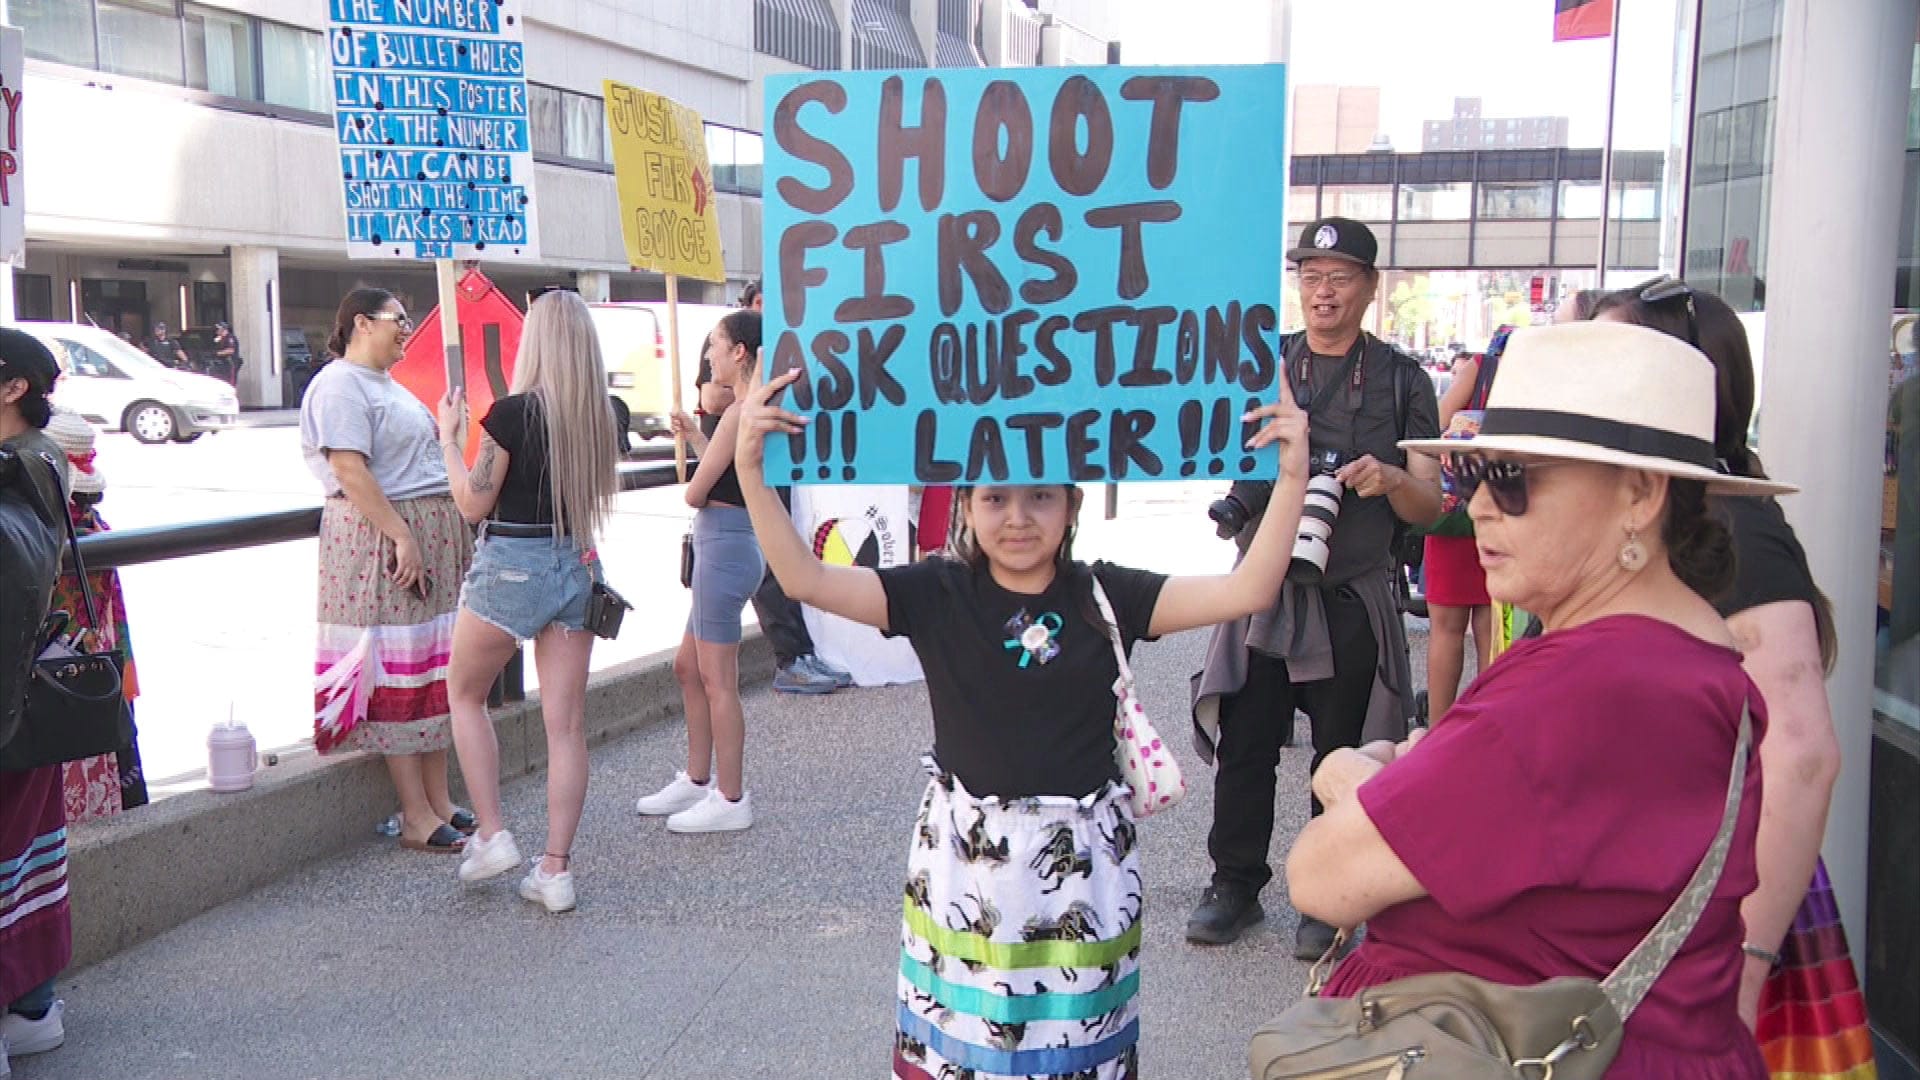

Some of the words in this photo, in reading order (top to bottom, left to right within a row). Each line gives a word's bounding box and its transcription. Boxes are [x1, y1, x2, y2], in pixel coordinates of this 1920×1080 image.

[337, 0, 382, 22] THE
[395, 0, 491, 31] NUMBER
[333, 31, 368, 67] OF
[376, 32, 460, 67] BULLET
[470, 41, 522, 73] HOLES
[335, 73, 380, 105] IN
[384, 75, 450, 108] THIS
[459, 80, 524, 114] POSTER
[341, 112, 388, 144] ARE
[396, 115, 440, 144] THE
[448, 118, 518, 149] NUMBER
[773, 75, 1221, 215] SHOOT
[342, 150, 413, 178] THAT
[421, 152, 478, 179] CAN
[484, 156, 507, 179] BE
[644, 152, 691, 205] FOR
[348, 183, 391, 208] SHOT
[398, 184, 423, 208] IN
[430, 184, 466, 209] THE
[474, 187, 523, 213] TIME
[349, 213, 374, 241] IT
[385, 212, 452, 241] TAKES
[460, 214, 473, 239] TO
[478, 216, 523, 242] READ
[636, 207, 712, 265] BOYCE
[421, 242, 449, 258] IT
[778, 200, 1183, 328] FIRST
[770, 325, 907, 411] ASK
[929, 299, 1277, 406] QUESTIONS
